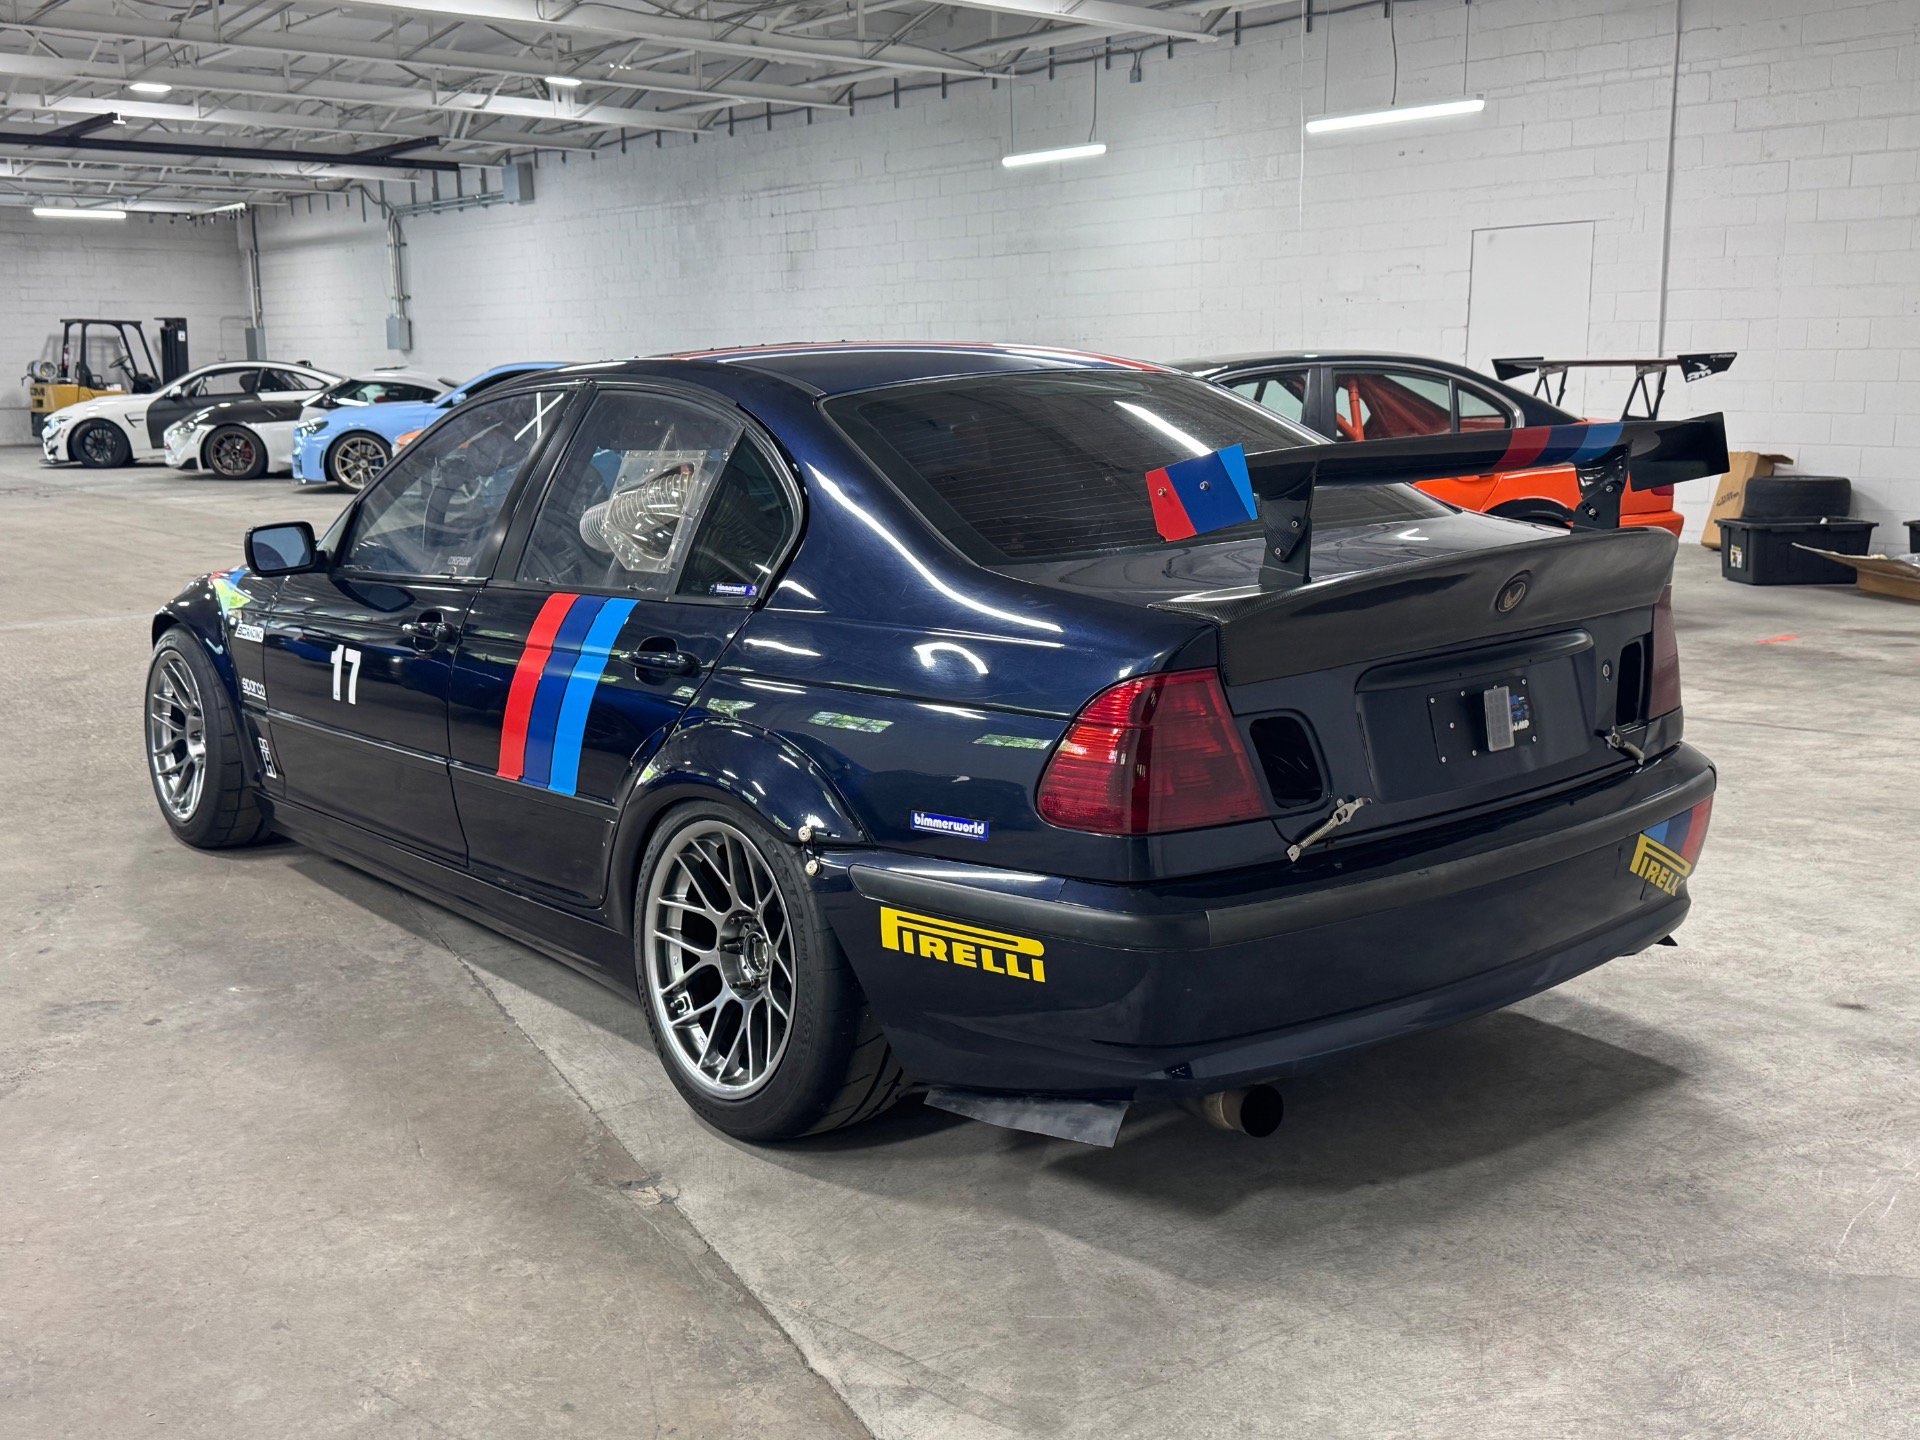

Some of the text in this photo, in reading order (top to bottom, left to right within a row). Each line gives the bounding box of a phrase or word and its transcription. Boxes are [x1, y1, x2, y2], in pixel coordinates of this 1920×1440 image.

[241, 677, 267, 699] sparco
[330, 643, 361, 705] 17
[914, 813, 985, 836] bimmerworld
[880, 906, 1046, 983] PIRELLI
